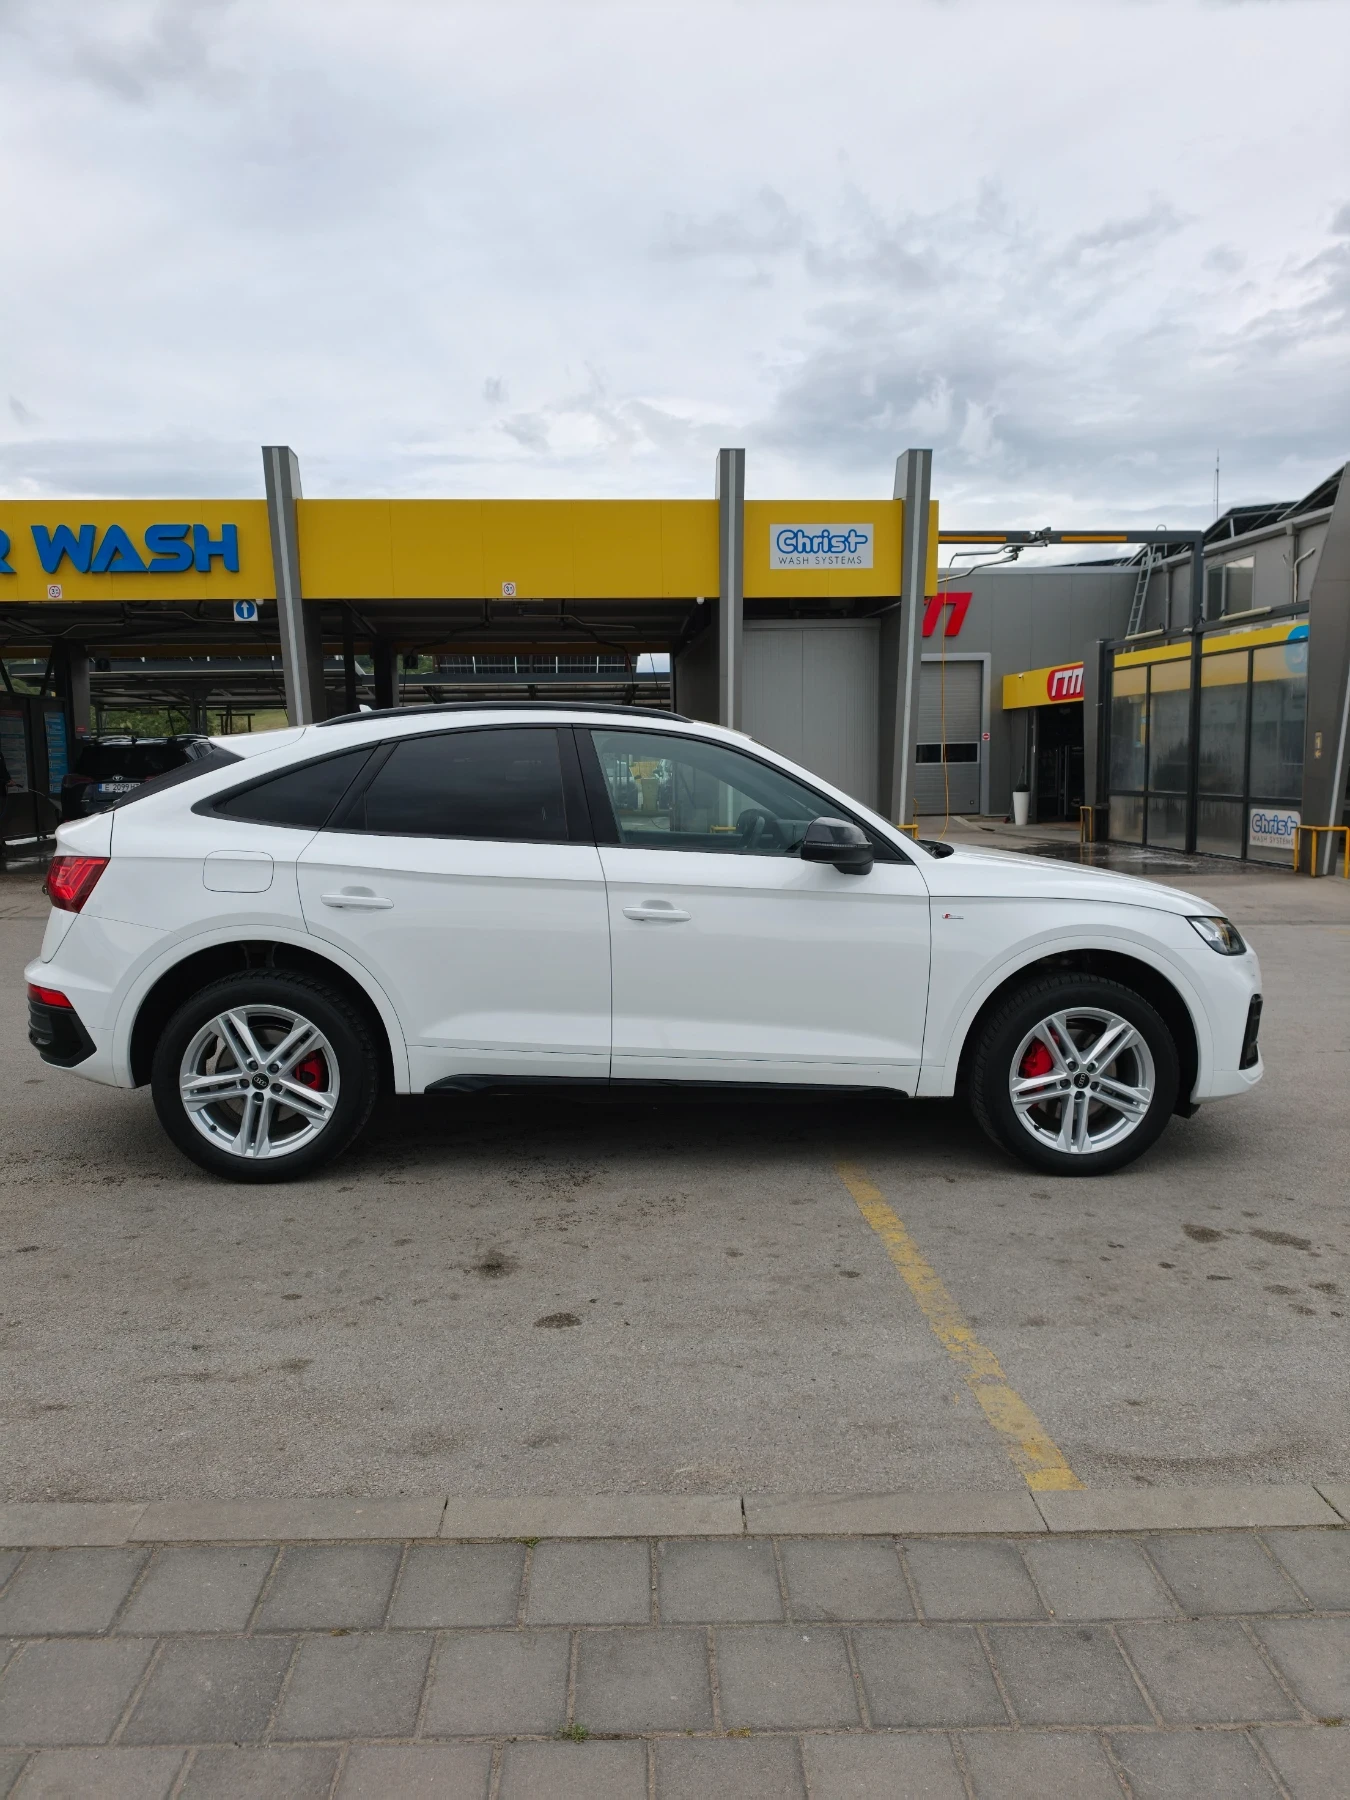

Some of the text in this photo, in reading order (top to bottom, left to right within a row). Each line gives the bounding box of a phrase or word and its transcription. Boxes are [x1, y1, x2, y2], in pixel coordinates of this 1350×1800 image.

[30, 524, 240, 574] WASH
[777, 529, 868, 553] Christ
[778, 556, 862, 565] WASH SYSTEMS
[1252, 814, 1297, 835] Christ
